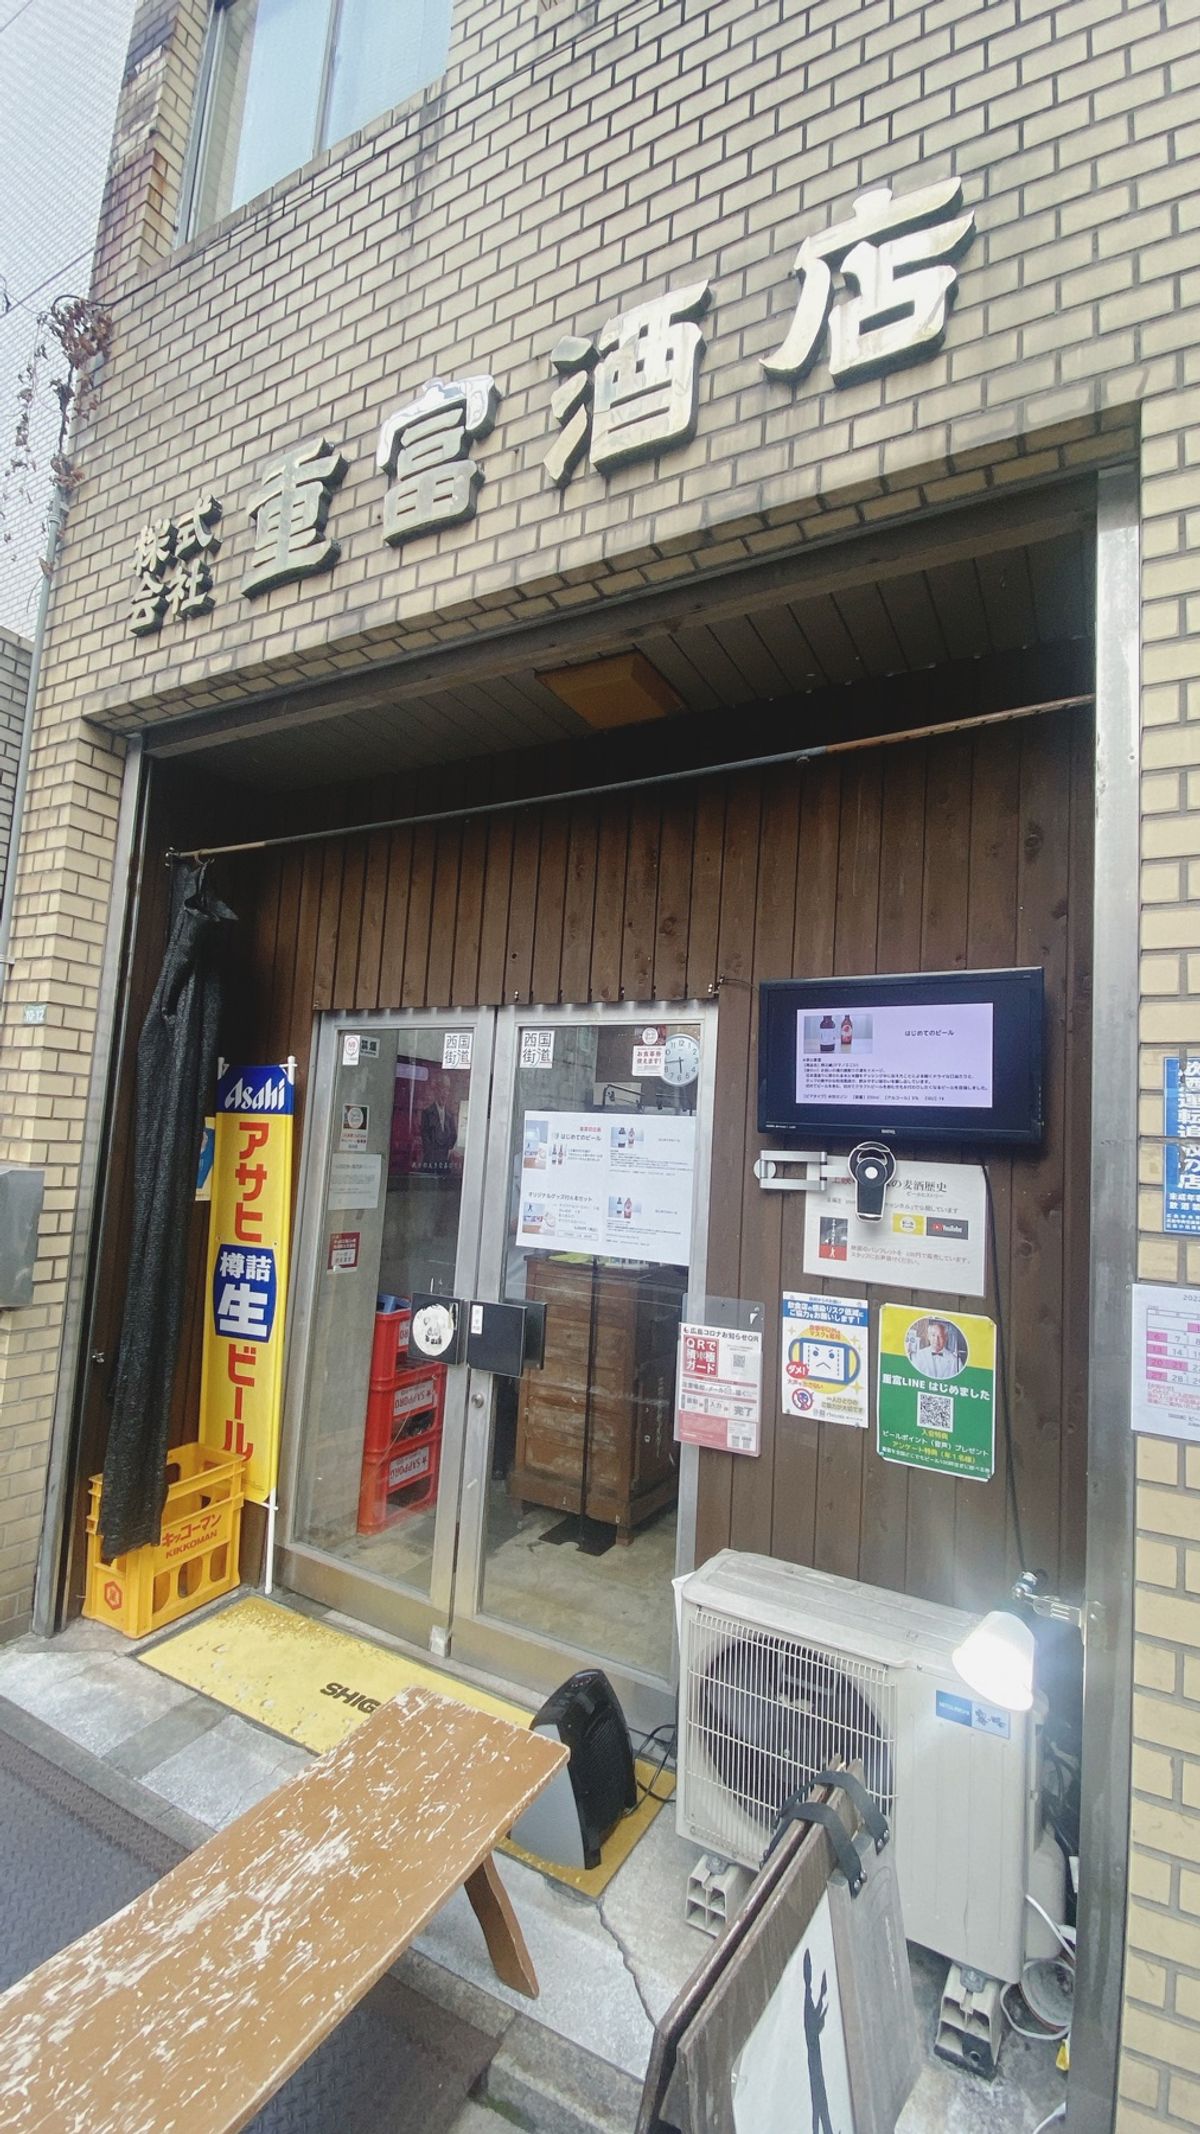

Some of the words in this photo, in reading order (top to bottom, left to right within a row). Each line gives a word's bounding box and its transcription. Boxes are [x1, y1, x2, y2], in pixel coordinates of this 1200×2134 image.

[243, 177, 976, 598] 重富酒店
[133, 494, 224, 580] 株式
[129, 557, 216, 636] 会社
[524, 1032, 552, 1048] 西国
[904, 1028, 955, 1037] はじめてのビール
[522, 1047, 552, 1066] 街道
[224, 1077, 286, 1112] Asahi
[220, 1250, 273, 1282] 樽詰
[217, 1283, 269, 1337] 生
[686, 1338, 716, 1351] QRで
[928, 1381, 991, 1401] はじめました
[162, 1514, 222, 1548] キッコーマン
[165, 1529, 218, 1559] KIKKOMAN
